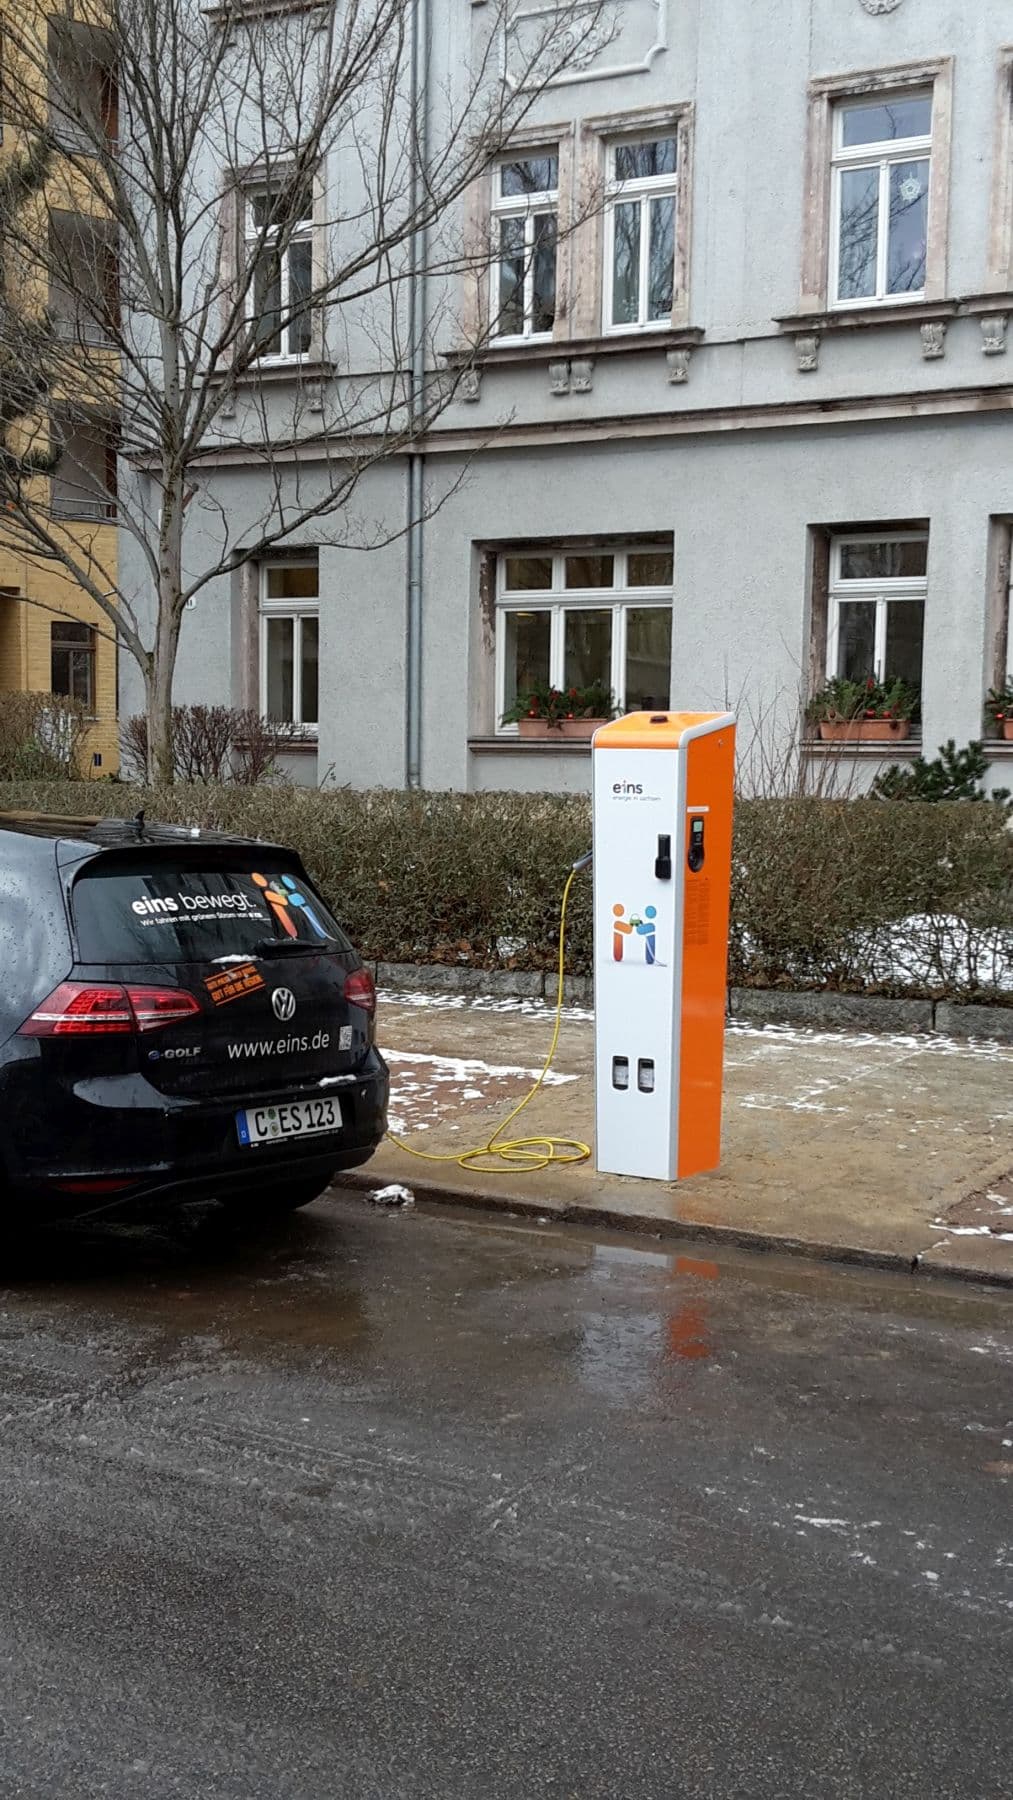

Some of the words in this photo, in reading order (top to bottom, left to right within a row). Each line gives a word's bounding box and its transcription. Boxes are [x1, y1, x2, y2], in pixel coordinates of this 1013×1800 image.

[612, 780, 643, 794] eins
[132, 896, 179, 915] eins
[178, 891, 257, 911] bewegt.
[227, 1030, 330, 1059] www.eins.de
[255, 1111, 268, 1137] C
[278, 1105, 302, 1133] ES
[304, 1100, 335, 1128] 123
